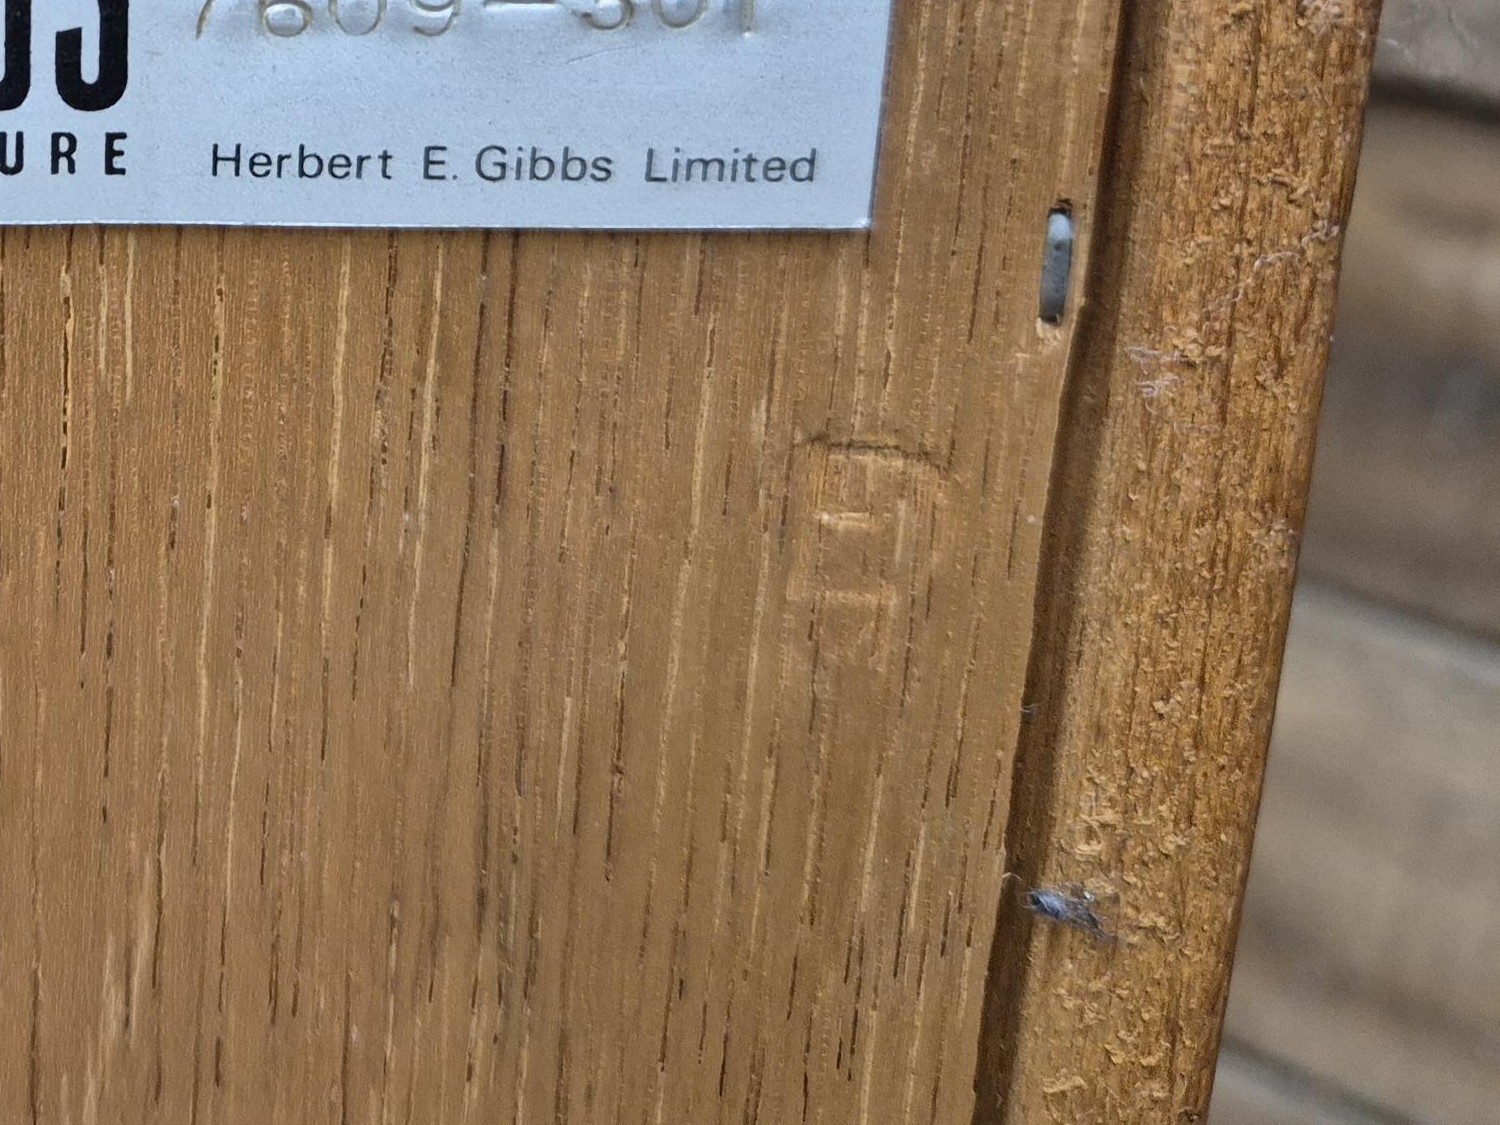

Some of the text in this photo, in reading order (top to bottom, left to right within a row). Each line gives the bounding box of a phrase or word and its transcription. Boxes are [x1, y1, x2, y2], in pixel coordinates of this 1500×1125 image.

[210, 142, 818, 184] Herbert E. Gibbs Limited
